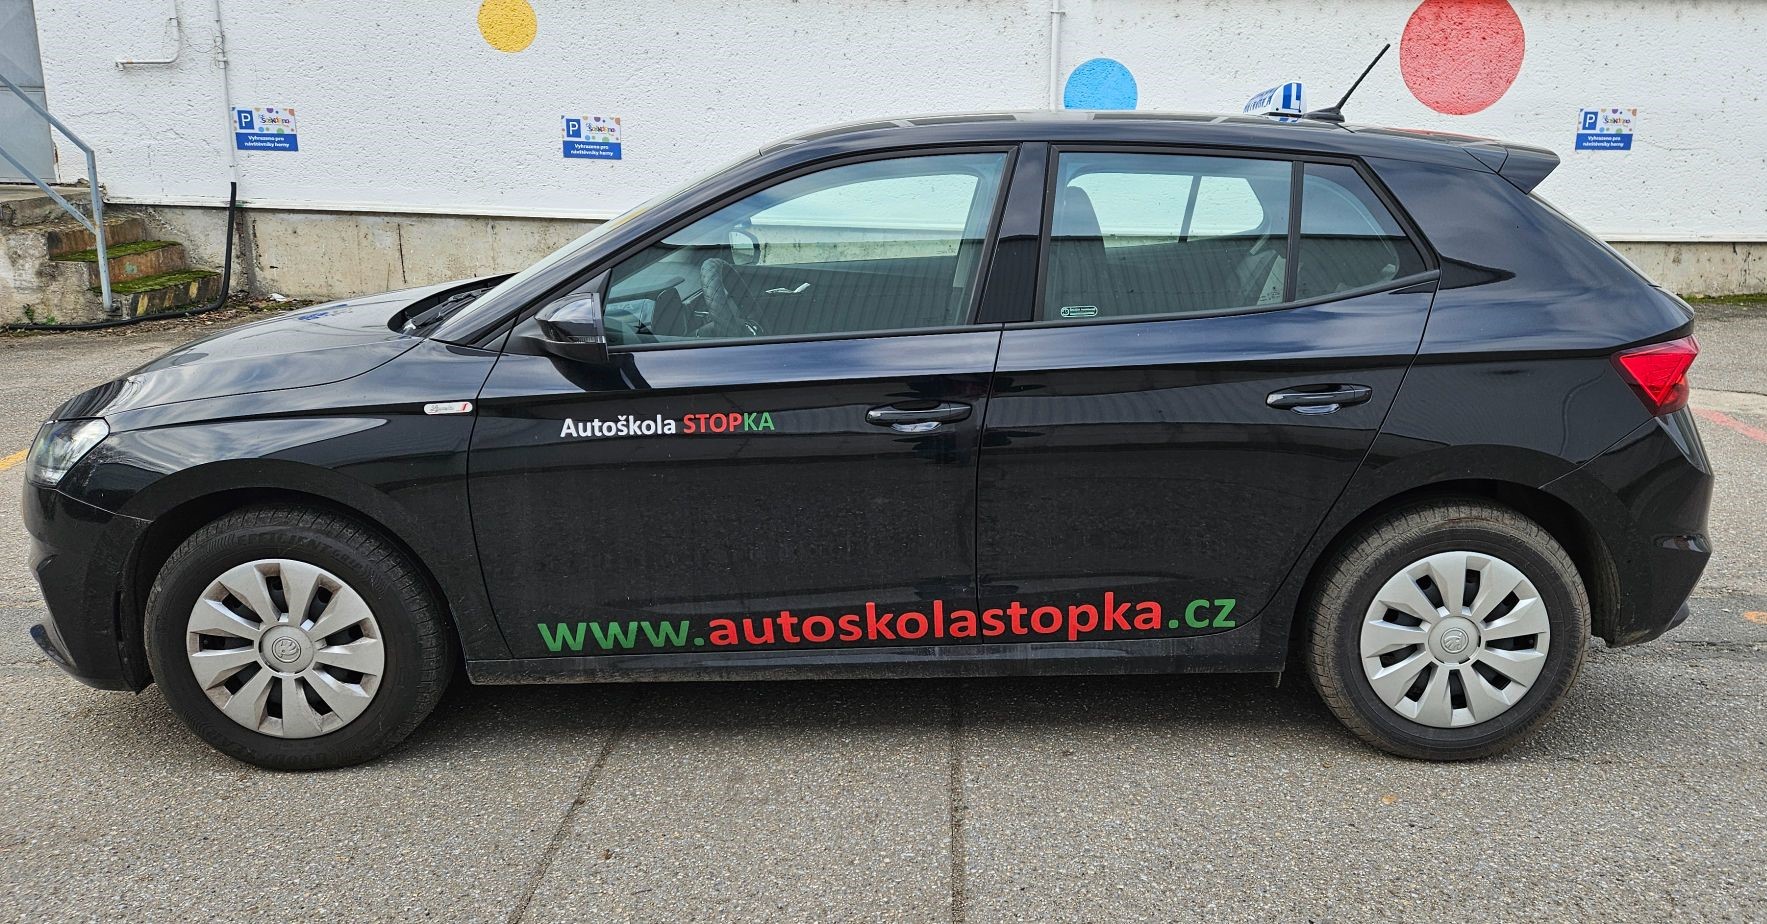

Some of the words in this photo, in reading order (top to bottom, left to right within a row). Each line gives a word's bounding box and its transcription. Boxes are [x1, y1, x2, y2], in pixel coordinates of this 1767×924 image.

[241, 113, 251, 127] P
[1585, 114, 1596, 128] P
[569, 121, 579, 135] P
[560, 414, 676, 438] Autoškola
[683, 412, 775, 434] STOPKA
[537, 591, 1236, 651] www.autoskolastopka.cz
